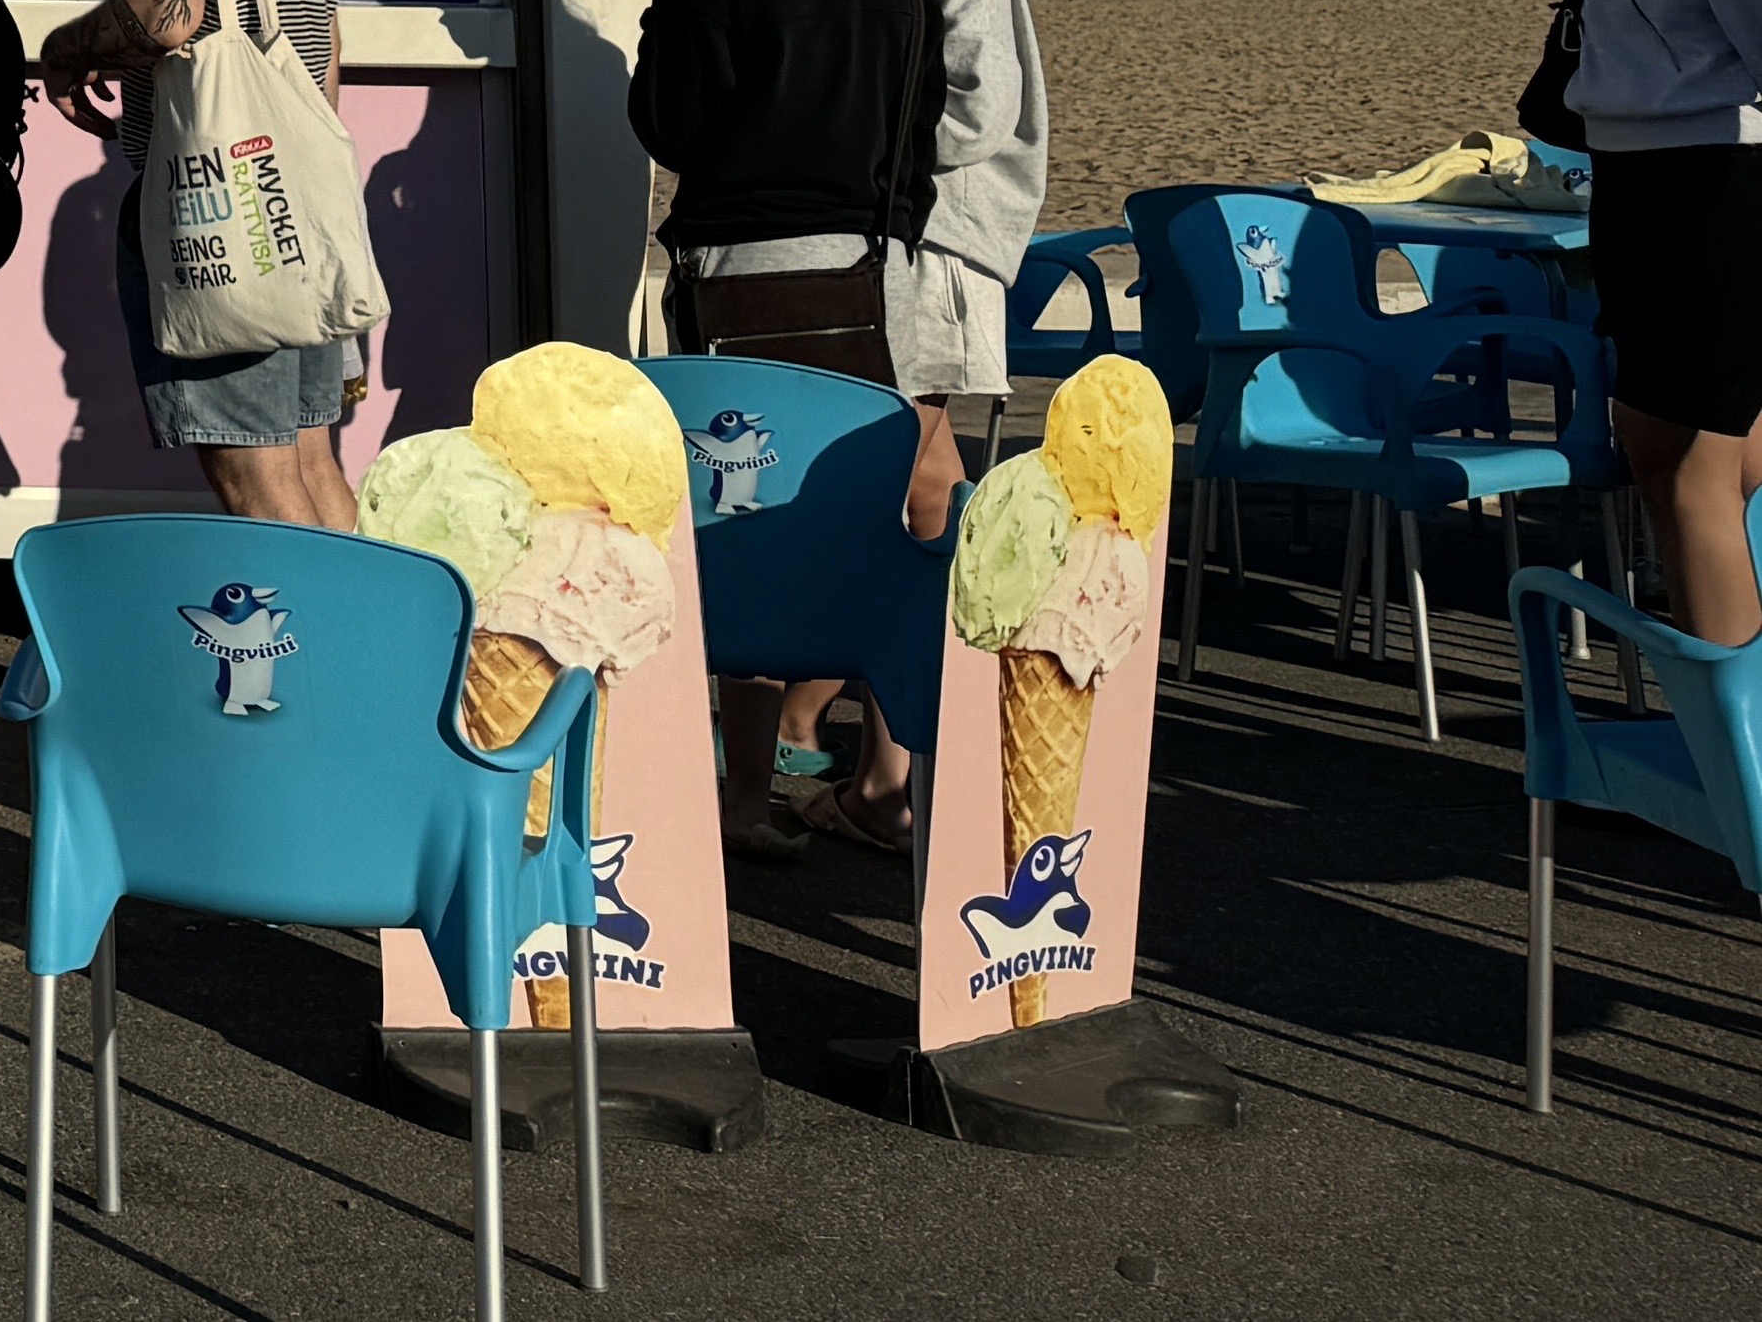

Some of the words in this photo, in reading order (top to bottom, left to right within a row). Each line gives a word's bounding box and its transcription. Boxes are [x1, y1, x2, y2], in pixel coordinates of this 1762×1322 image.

[251, 153, 306, 266] MYCKET
[693, 450, 777, 473] Pingviini
[194, 633, 297, 664] Pingviini
[970, 945, 1096, 999] PINGVIINI
